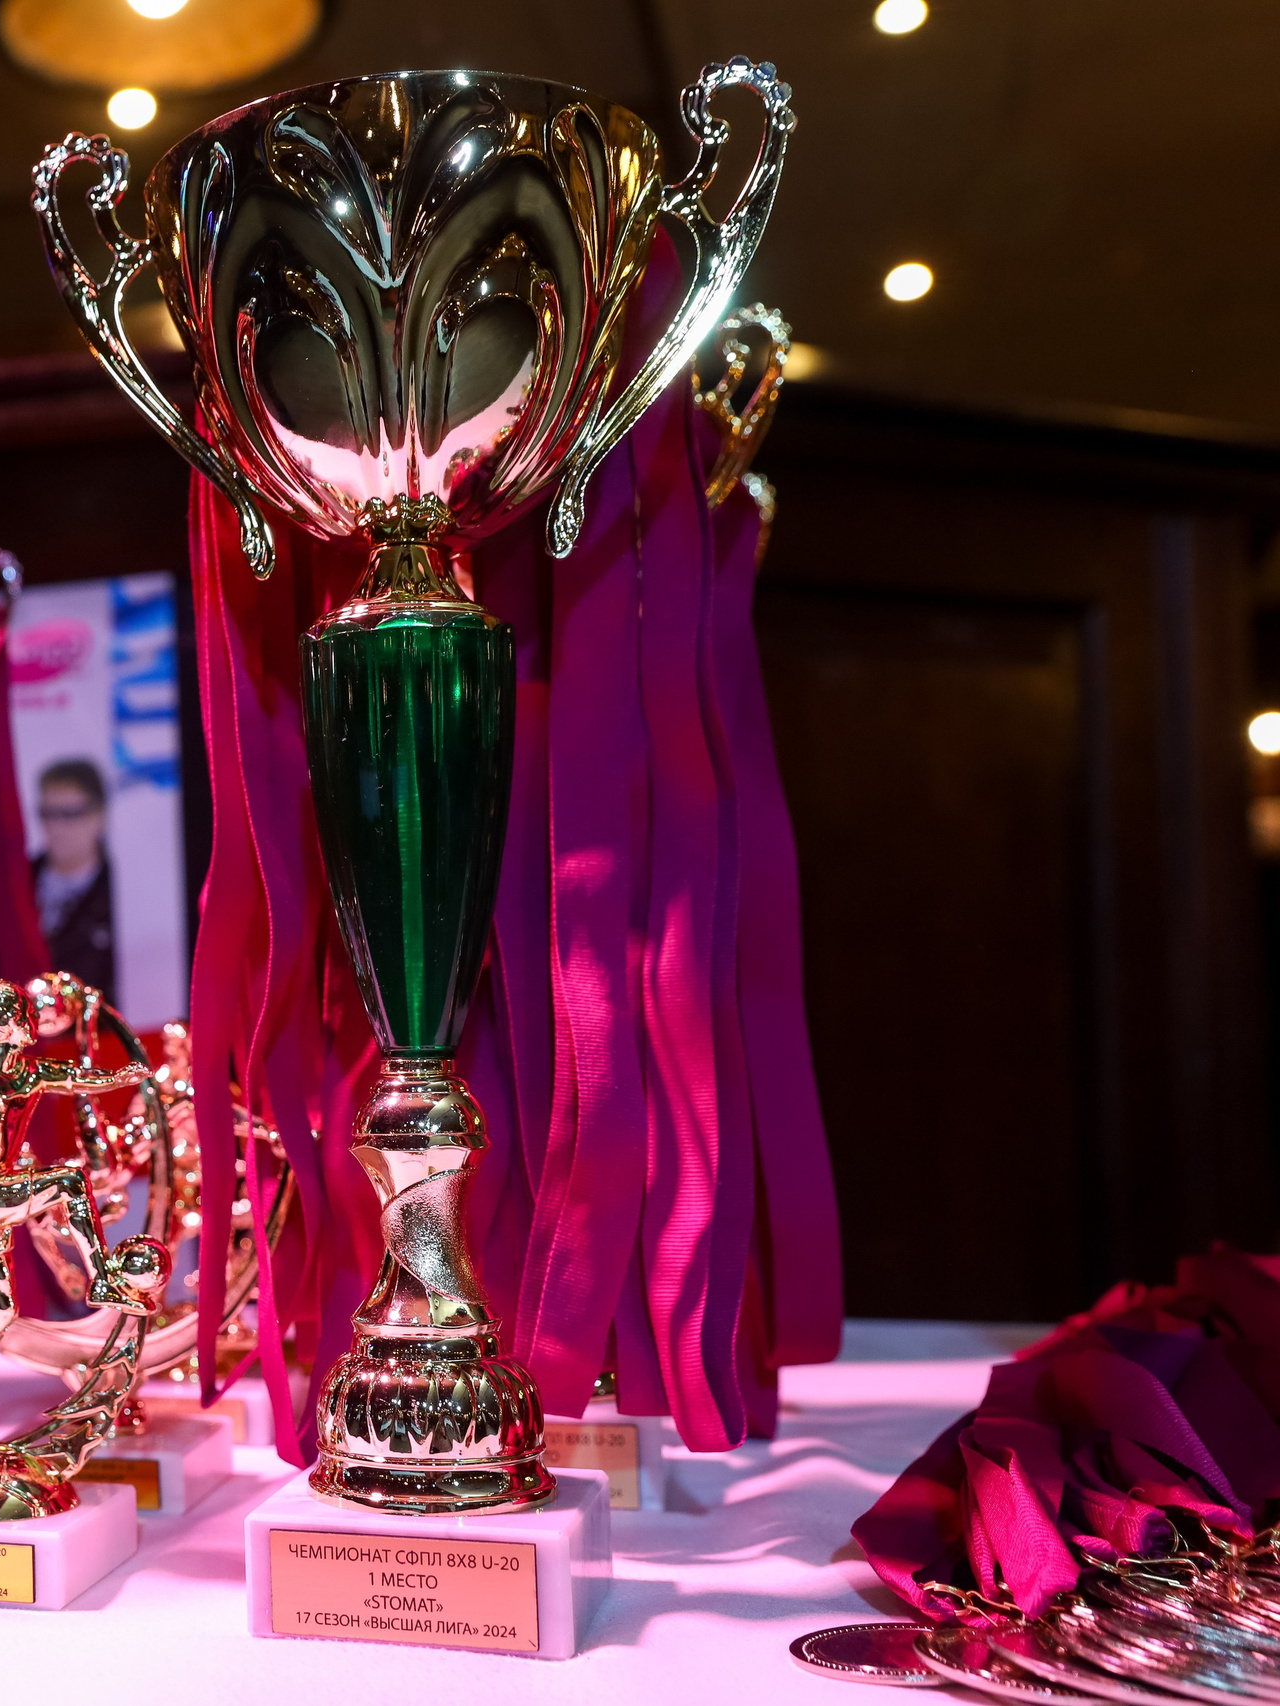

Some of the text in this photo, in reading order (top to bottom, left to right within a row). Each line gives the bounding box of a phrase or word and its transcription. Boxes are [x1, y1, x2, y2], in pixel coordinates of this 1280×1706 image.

[289, 1544, 520, 1571] ЧЕМПИОНАТ СФПЛ 8X8 U-20
[368, 1571, 438, 1589] 1 МЕСТО
[363, 1595, 444, 1613] «STOMAT»
[296, 1611, 517, 1638] 17 СЕЗОН «ВЫСШАЯ ЛИГА» 2024
